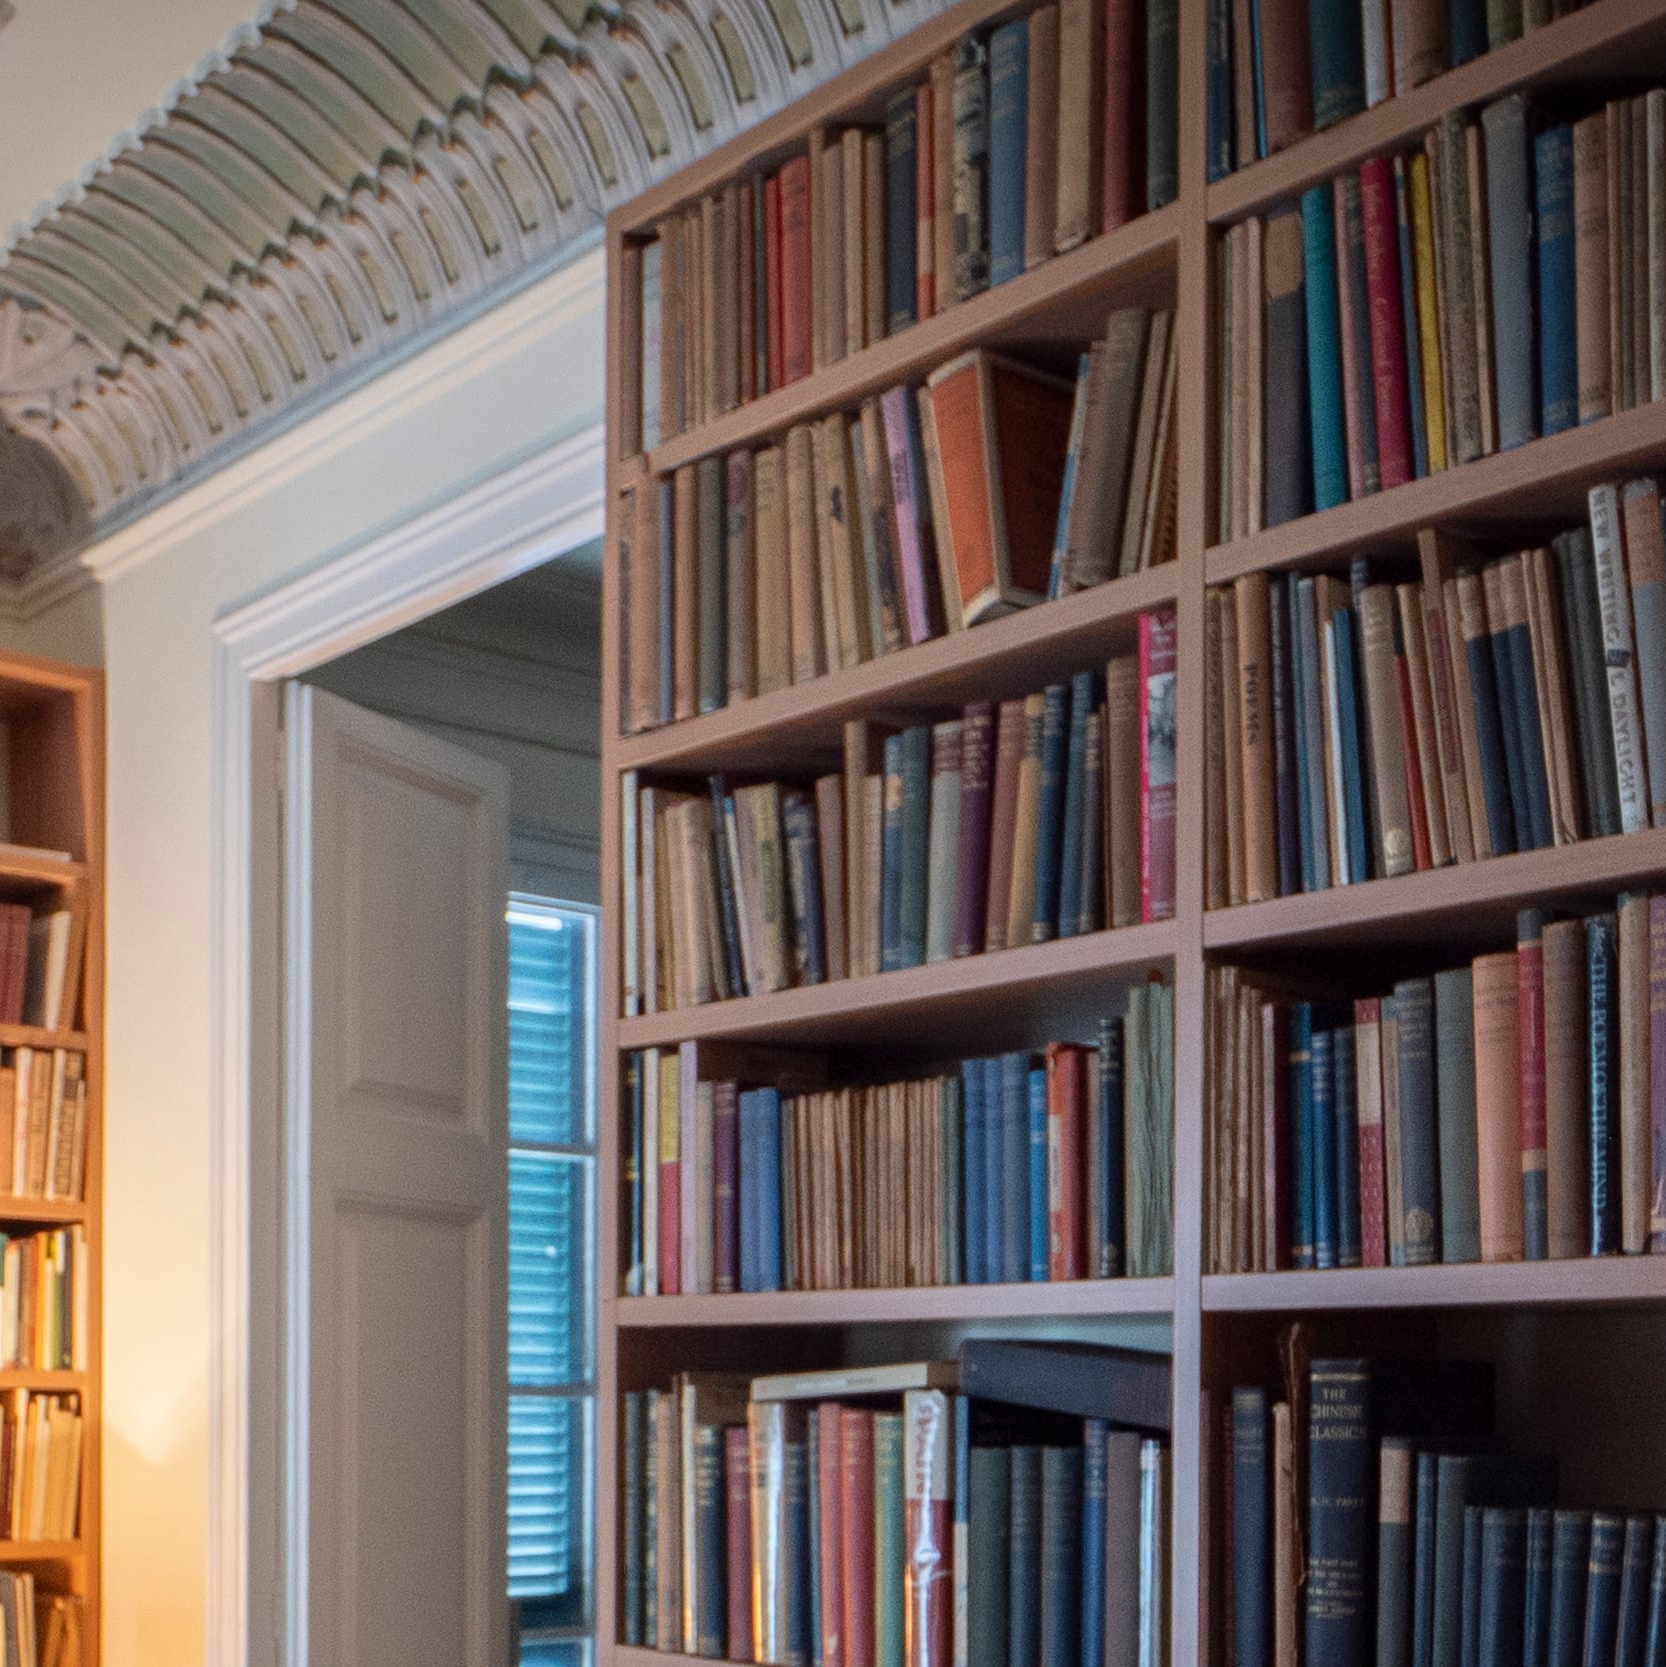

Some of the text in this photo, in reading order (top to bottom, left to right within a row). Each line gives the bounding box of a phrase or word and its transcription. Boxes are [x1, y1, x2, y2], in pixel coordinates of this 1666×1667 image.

[1591, 486, 1639, 804] NEW WRITING DAYLIGHT
[1322, 1387, 1347, 1400] THE
